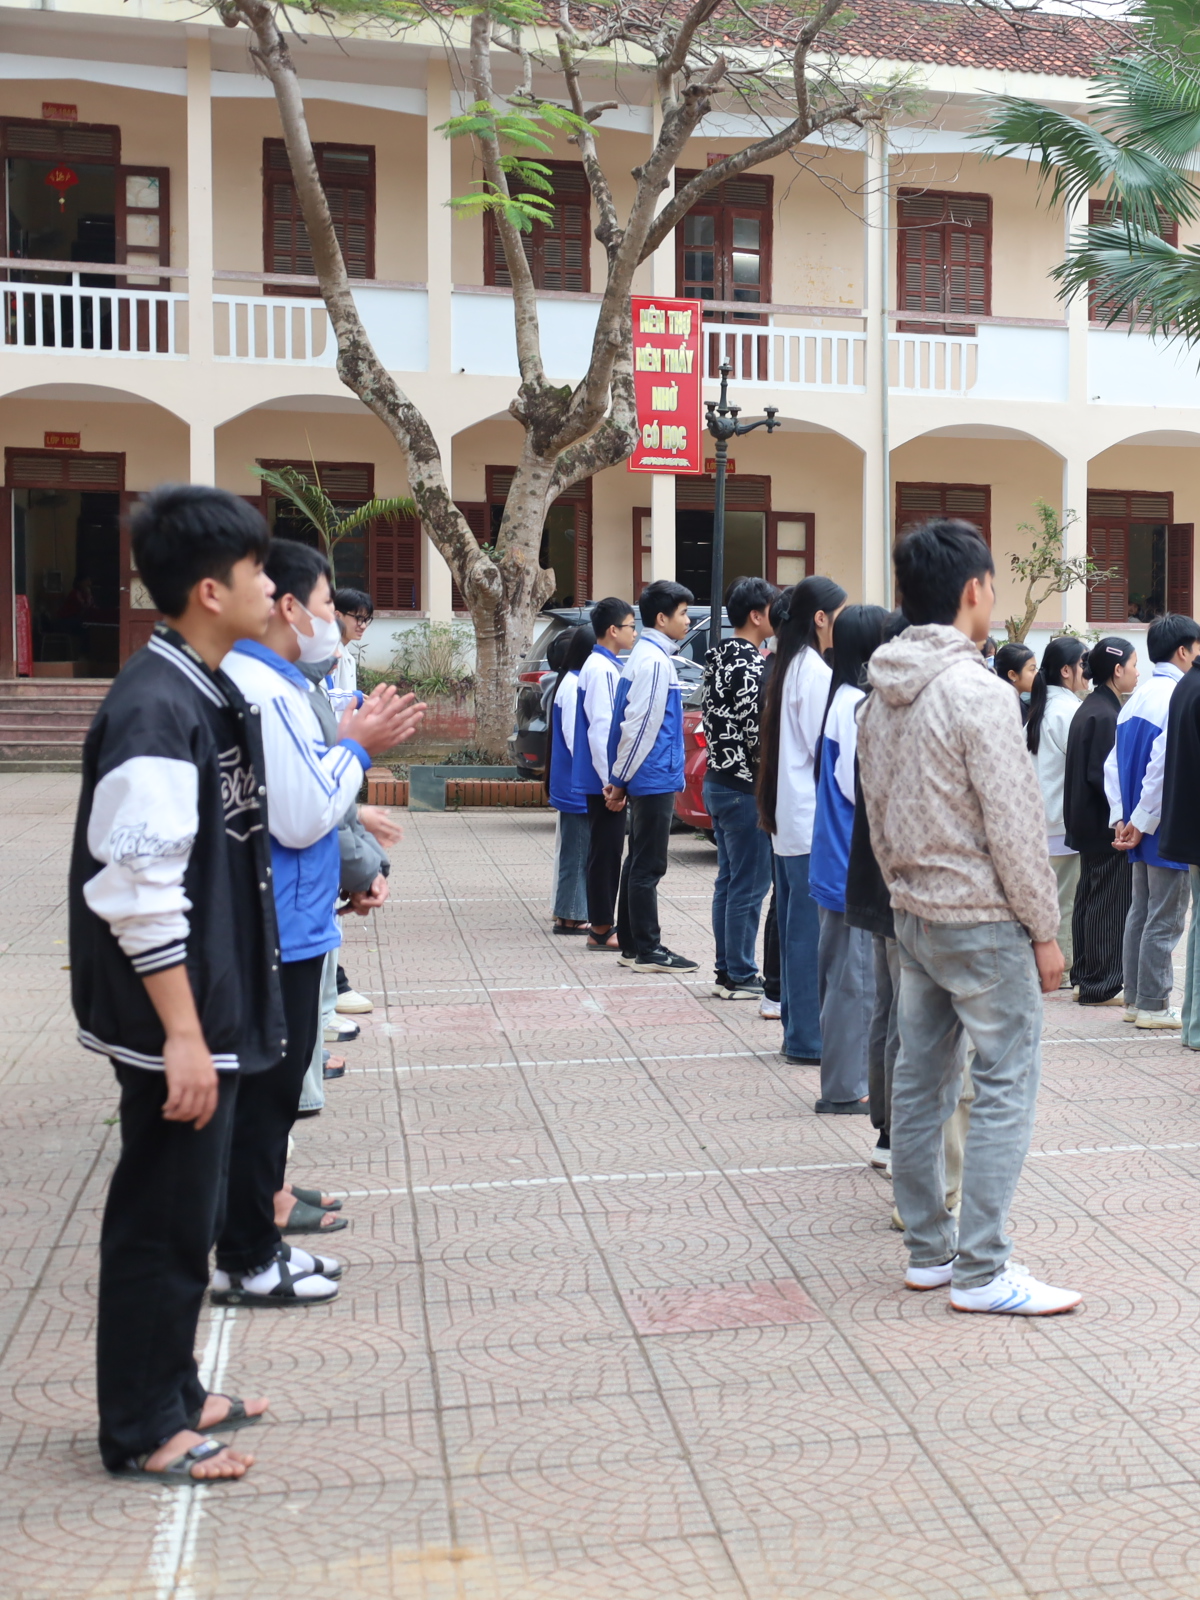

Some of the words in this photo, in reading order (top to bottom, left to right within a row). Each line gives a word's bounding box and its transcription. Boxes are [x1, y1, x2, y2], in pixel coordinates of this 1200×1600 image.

[639, 304, 666, 334] NÊN
[667, 310, 692, 340] THỢ
[635, 343, 661, 372] NÊN
[663, 341, 694, 374] THẦY
[651, 380, 679, 411] NHỜ
[642, 419, 660, 449] CÓ
[661, 425, 687, 455] HỌC
